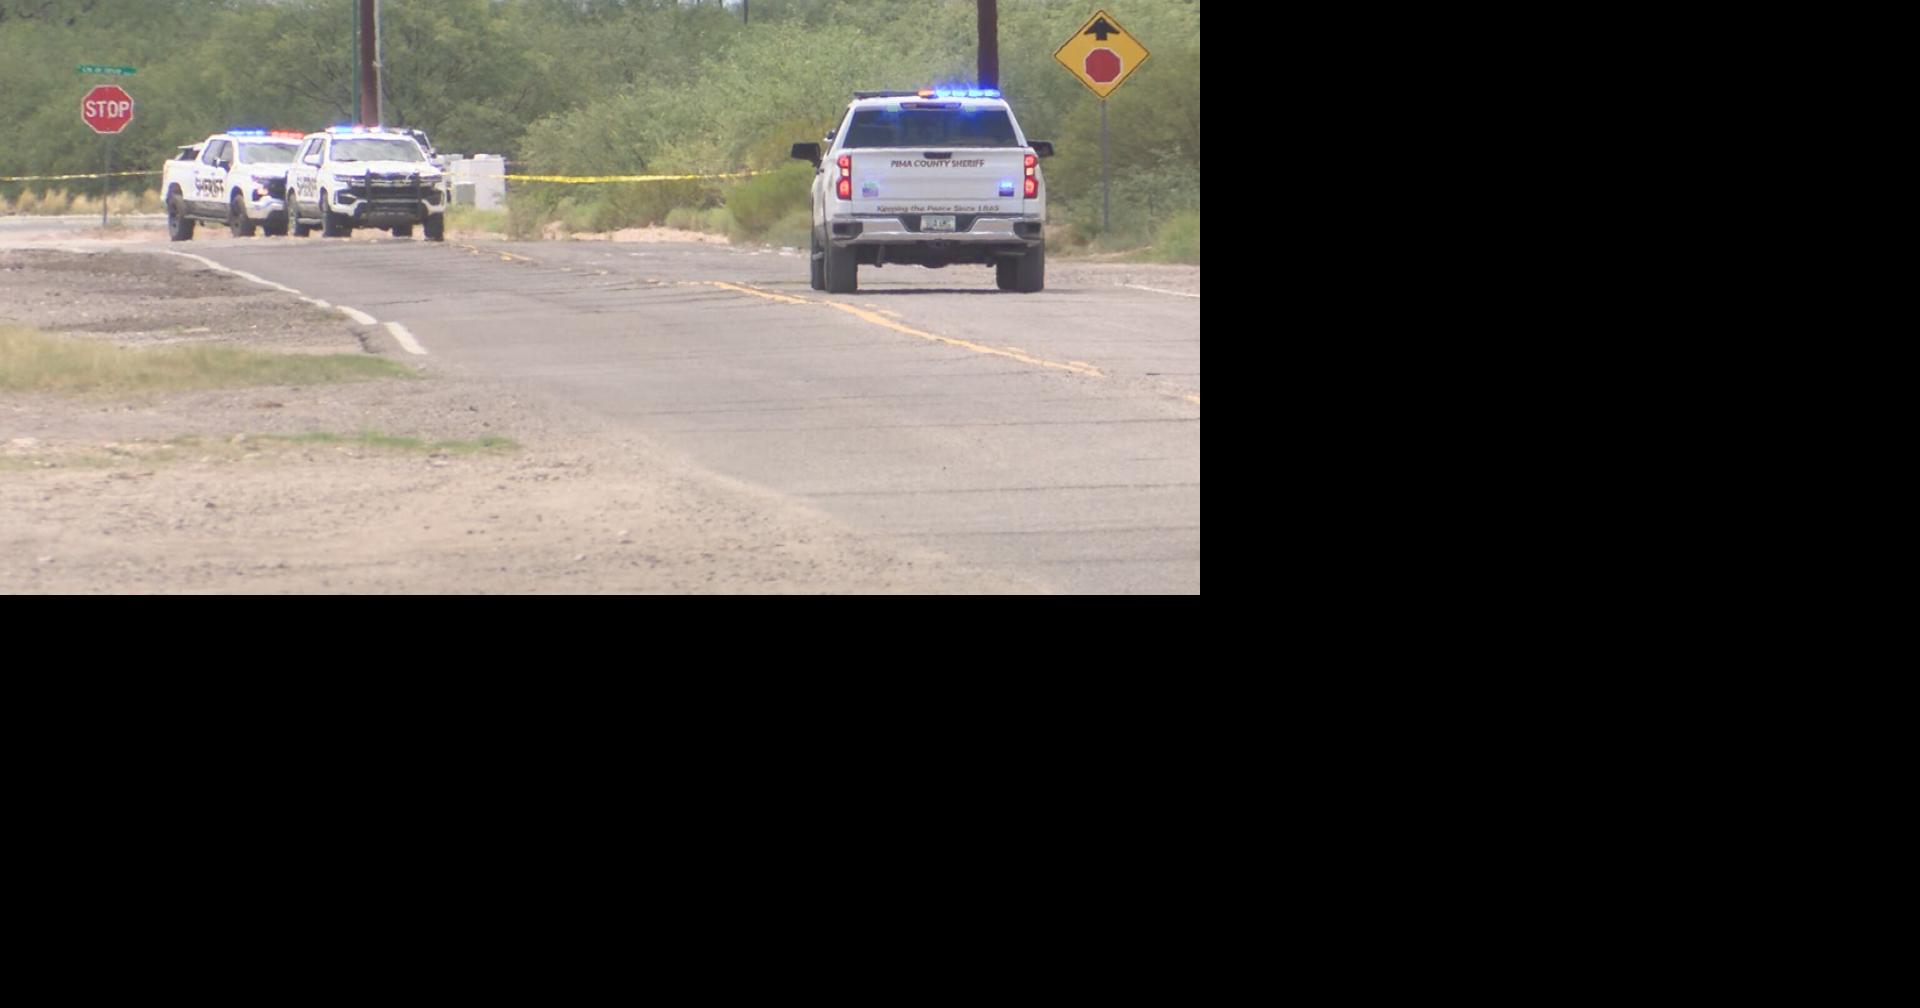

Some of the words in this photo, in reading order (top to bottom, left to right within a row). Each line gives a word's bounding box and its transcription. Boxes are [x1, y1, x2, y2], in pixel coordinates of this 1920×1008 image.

[85, 100, 130, 118] STOP
[891, 160, 912, 168] PIMA
[914, 160, 950, 168] COUNTY
[951, 159, 985, 168] SHERIFF
[911, 204, 925, 212] the
